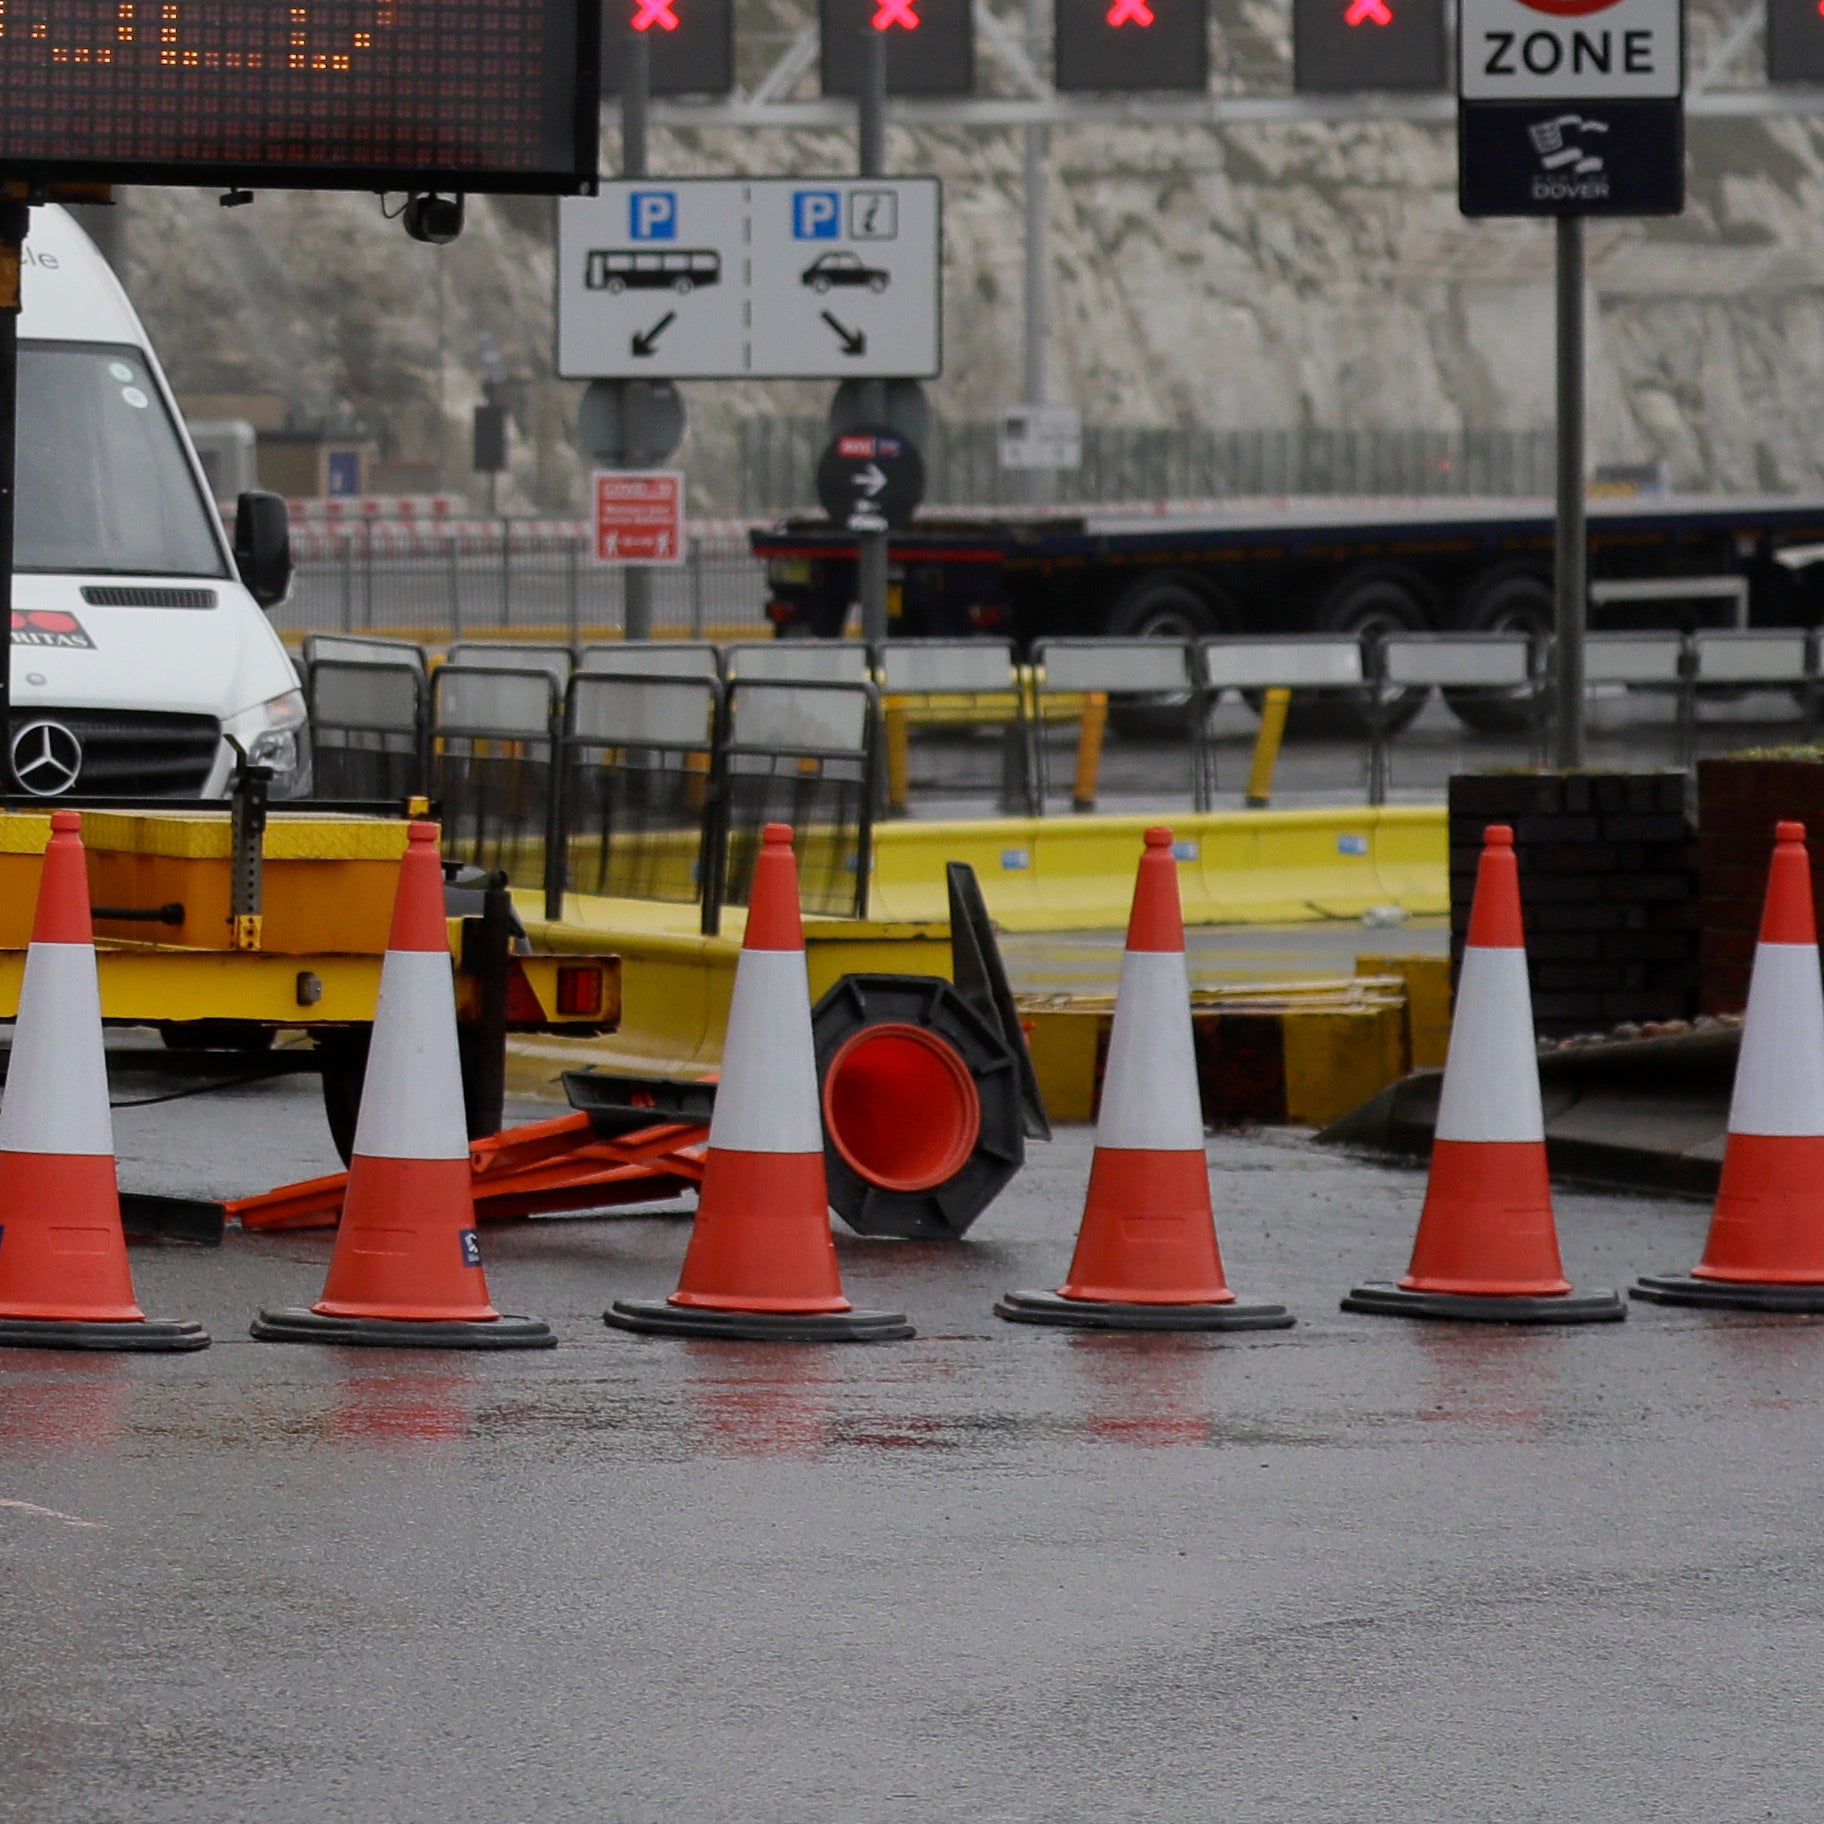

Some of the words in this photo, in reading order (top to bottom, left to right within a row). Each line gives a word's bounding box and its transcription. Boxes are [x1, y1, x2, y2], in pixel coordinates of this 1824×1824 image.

[1484, 30, 1655, 76] ZONE
[640, 196, 672, 237] P
[803, 196, 835, 237] P
